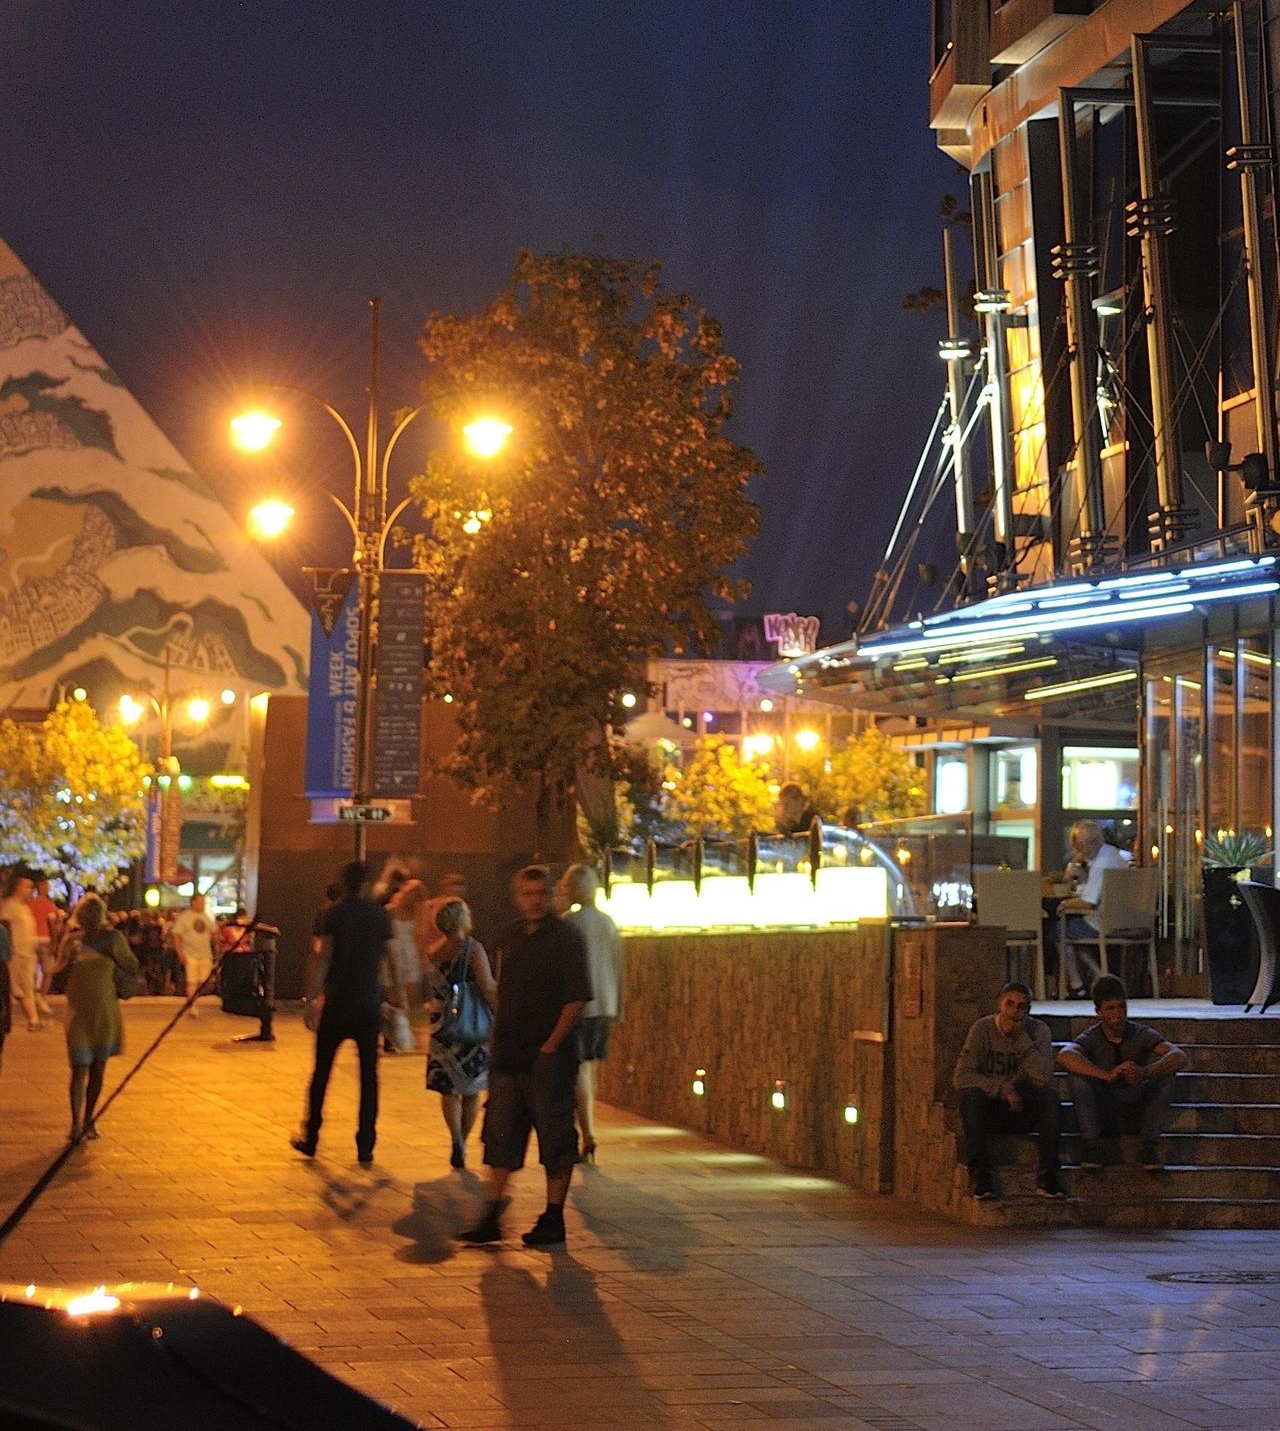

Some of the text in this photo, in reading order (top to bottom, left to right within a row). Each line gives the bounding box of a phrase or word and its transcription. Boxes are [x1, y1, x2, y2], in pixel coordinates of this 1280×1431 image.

[346, 606, 360, 661] SOPOT
[328, 650, 344, 696] WEEK
[342, 715, 357, 789] FASHION
[341, 807, 366, 821] WC
